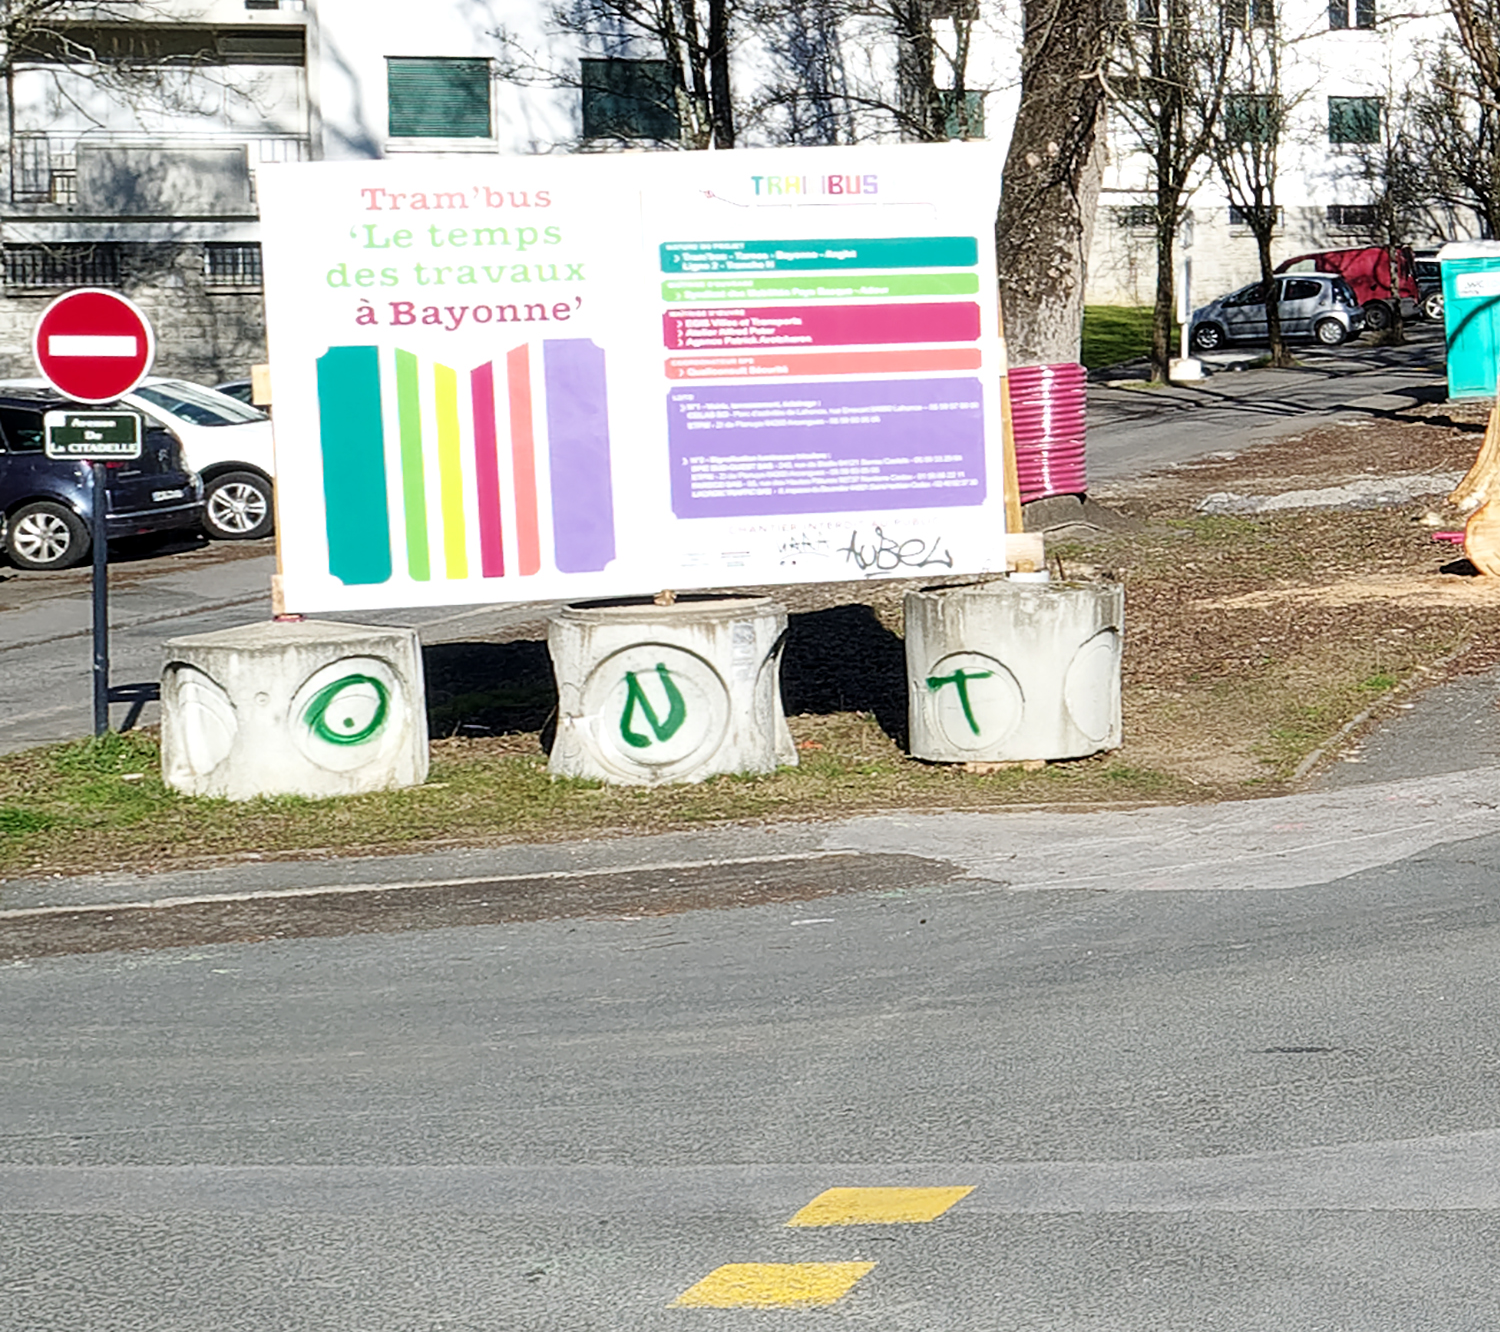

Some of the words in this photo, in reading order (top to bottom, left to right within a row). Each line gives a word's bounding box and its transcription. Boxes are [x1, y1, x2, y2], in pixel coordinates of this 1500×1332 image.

[361, 186, 552, 210] Tram'bus
[427, 224, 562, 251] temps
[326, 263, 399, 288] des
[414, 262, 586, 286] travaux
[355, 298, 378, 326] à
[388, 296, 582, 331] Bayonne'
[68, 443, 138, 452] CITADELLE
[926, 669, 995, 736] T
